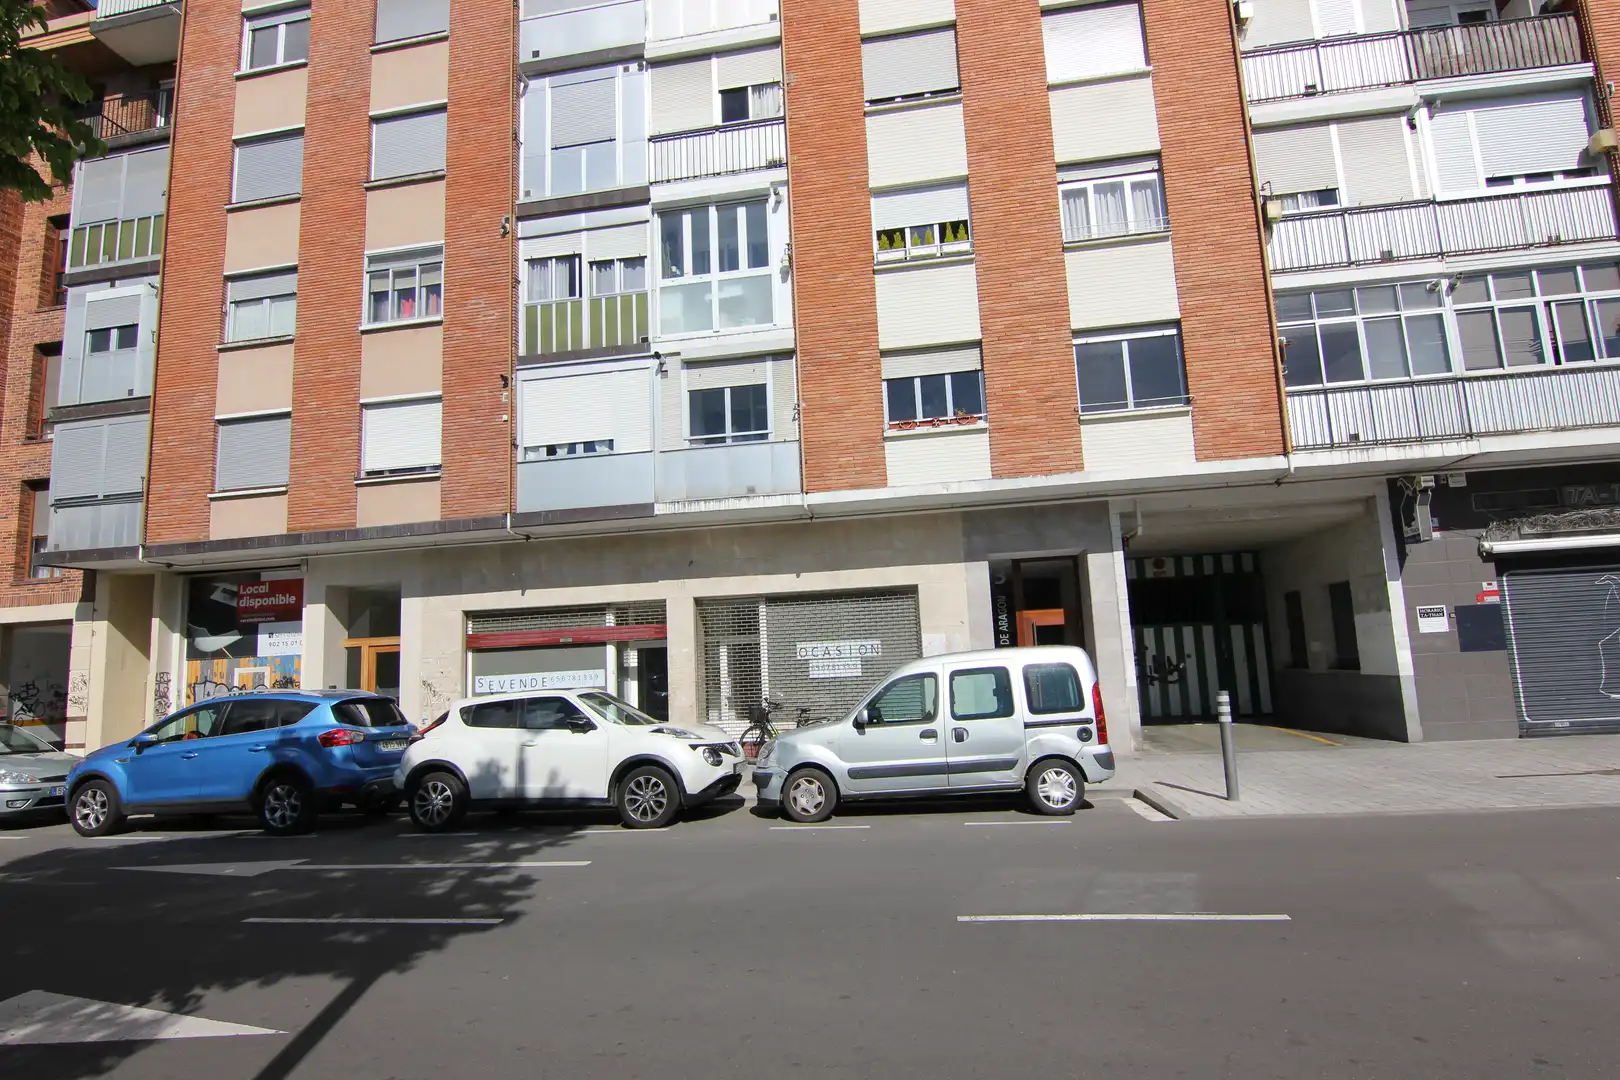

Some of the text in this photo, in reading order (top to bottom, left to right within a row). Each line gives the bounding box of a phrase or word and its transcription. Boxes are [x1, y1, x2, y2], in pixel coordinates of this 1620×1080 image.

[240, 583, 269, 594] Local
[239, 594, 296, 608] disponible
[997, 595, 1009, 632] ARAGON
[1000, 634, 1010, 645] DE
[799, 644, 880, 658] OCASION
